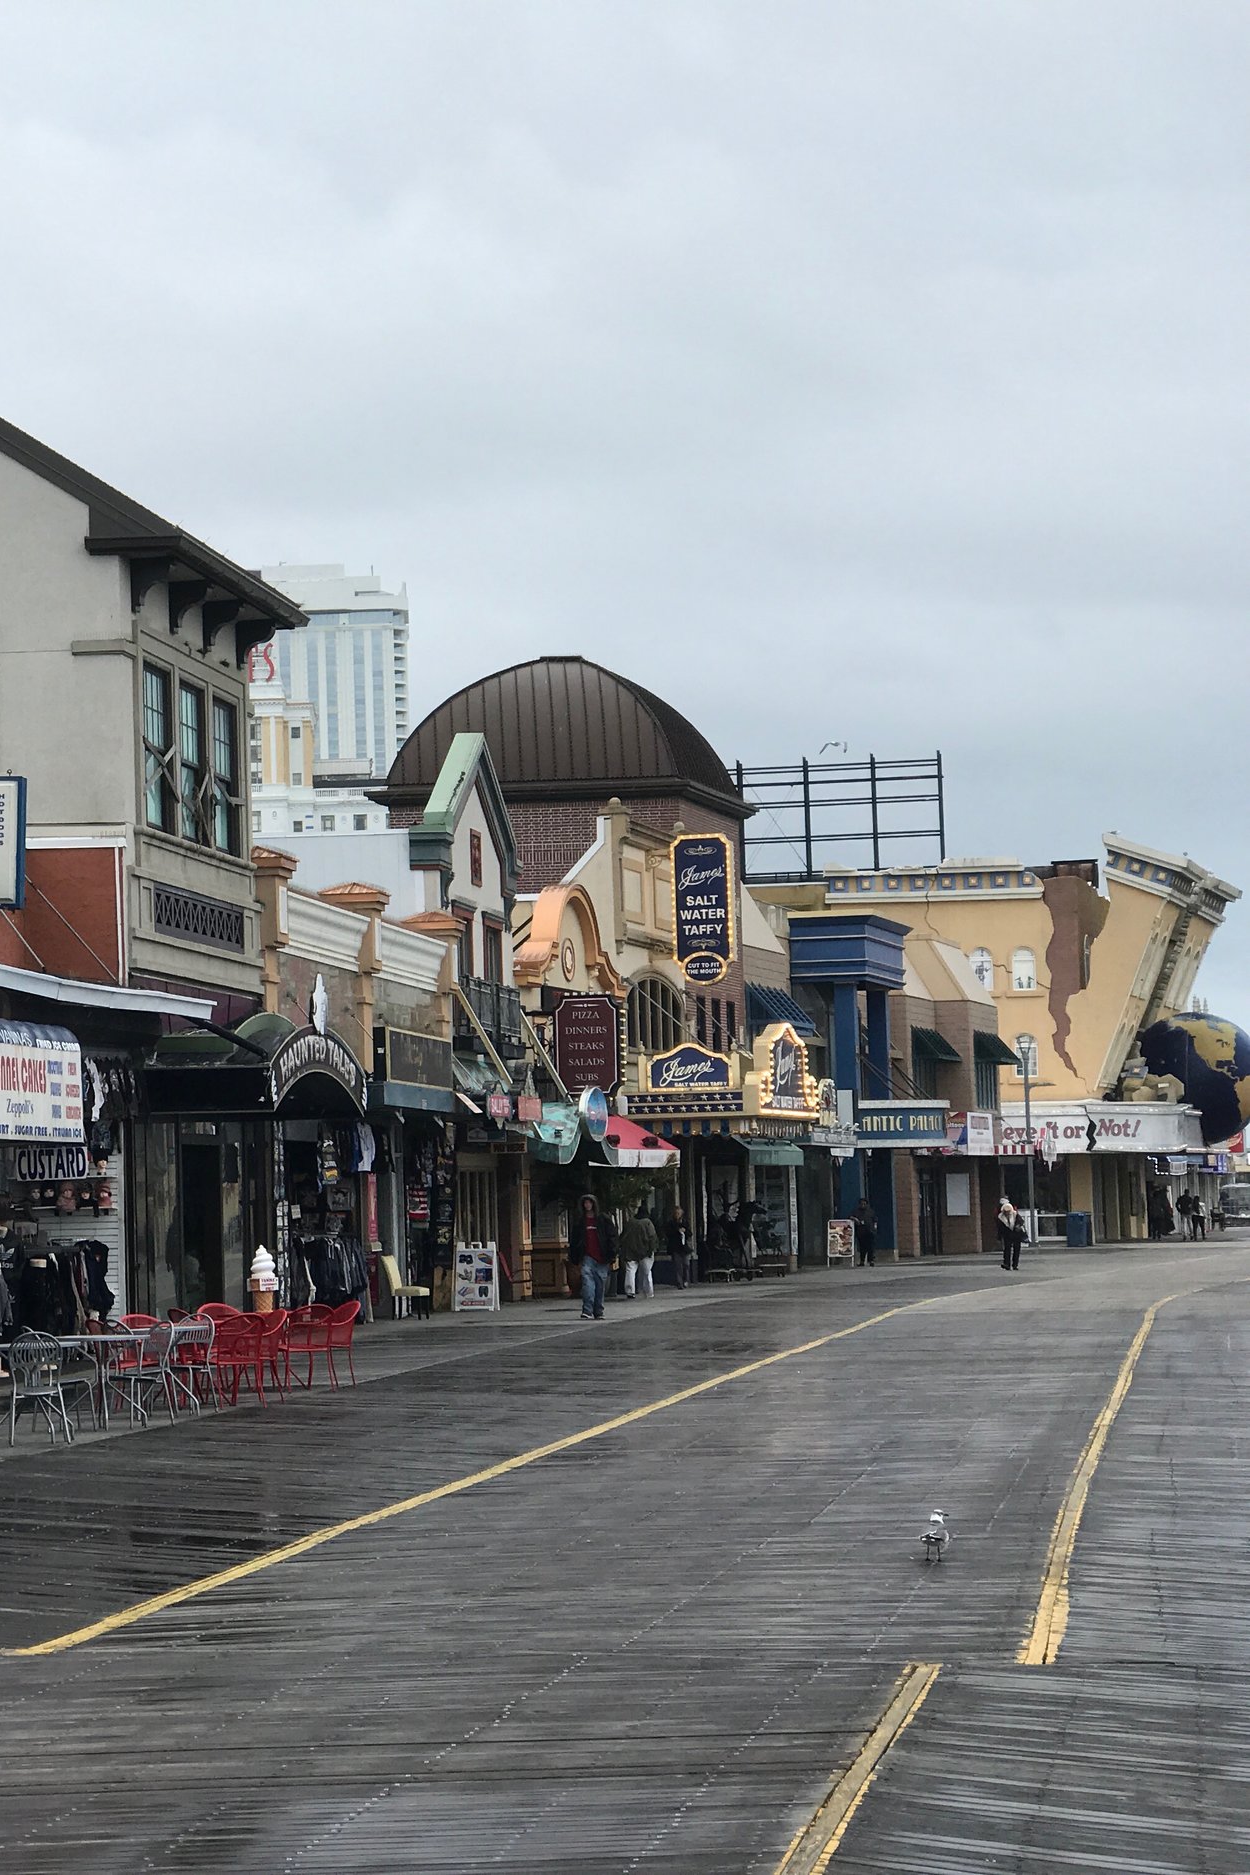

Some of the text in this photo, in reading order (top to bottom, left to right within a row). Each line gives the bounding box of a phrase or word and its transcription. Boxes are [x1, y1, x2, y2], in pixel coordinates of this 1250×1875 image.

[686, 894, 719, 907] SALT
[679, 908, 726, 921] WATER
[682, 923, 723, 936] TAFFY
[572, 1010, 600, 1019] PIZZA
[565, 1025, 608, 1035] DINNERS
[568, 1042, 605, 1050] STEAKS
[279, 1034, 327, 1084] HAUNTED
[568, 1057, 605, 1066] SALADS
[20, 1058, 47, 1095] CAKES
[575, 1073, 599, 1081] SUBS
[14, 1124, 33, 1136] SUGAR
[34, 1125, 48, 1137] FREE
[1063, 1125, 1086, 1139] or
[1096, 1118, 1142, 1138] Not!
[17, 1147, 87, 1181] CUSTARD
